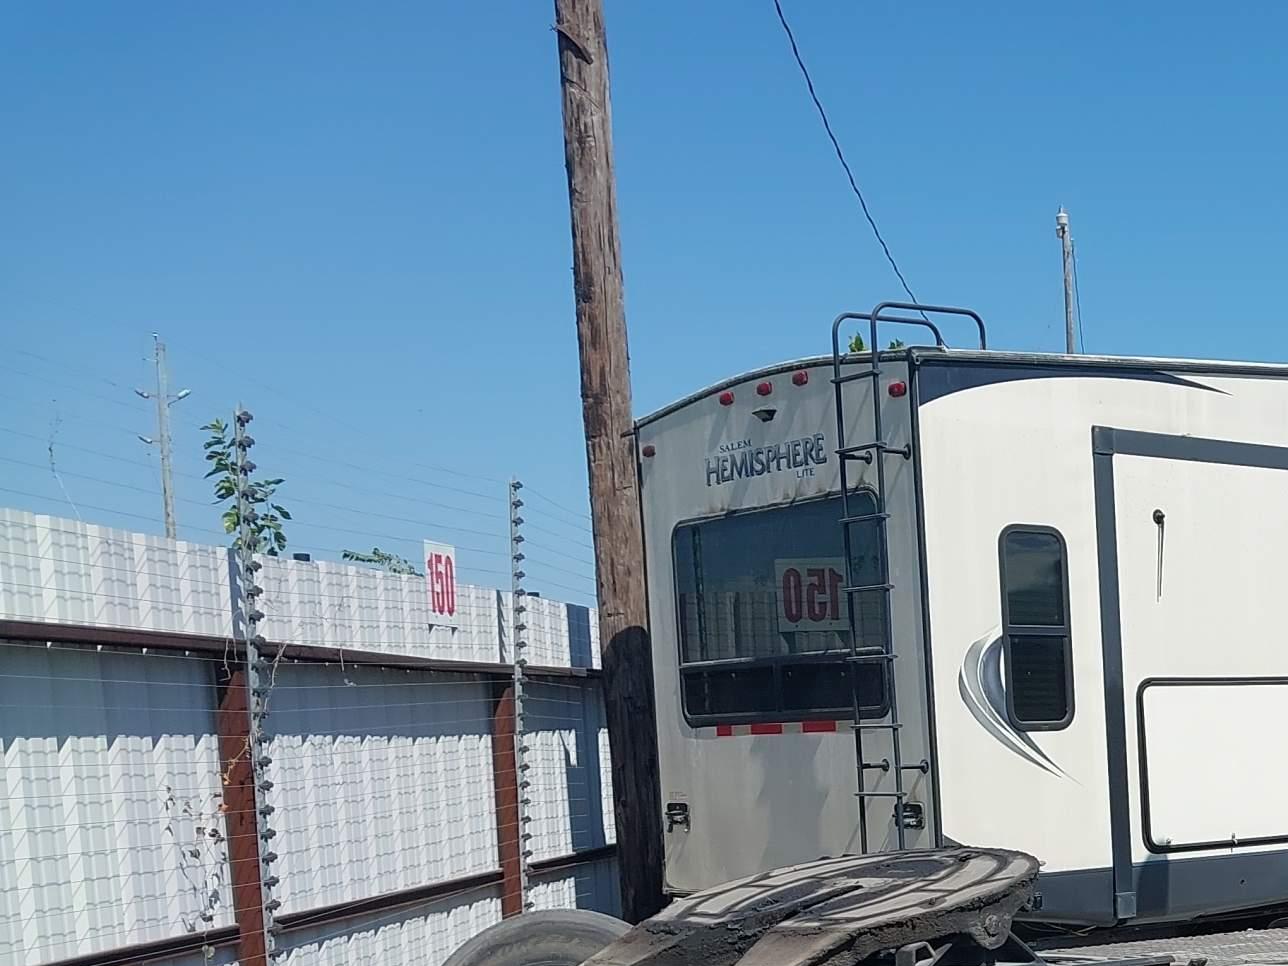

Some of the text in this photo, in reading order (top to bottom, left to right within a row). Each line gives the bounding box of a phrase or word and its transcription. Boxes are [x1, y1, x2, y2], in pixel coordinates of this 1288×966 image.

[704, 433, 828, 487] HEMISPHERE
[719, 438, 752, 454] SALEM
[795, 467, 816, 479] LITE
[427, 552, 455, 617] 150
